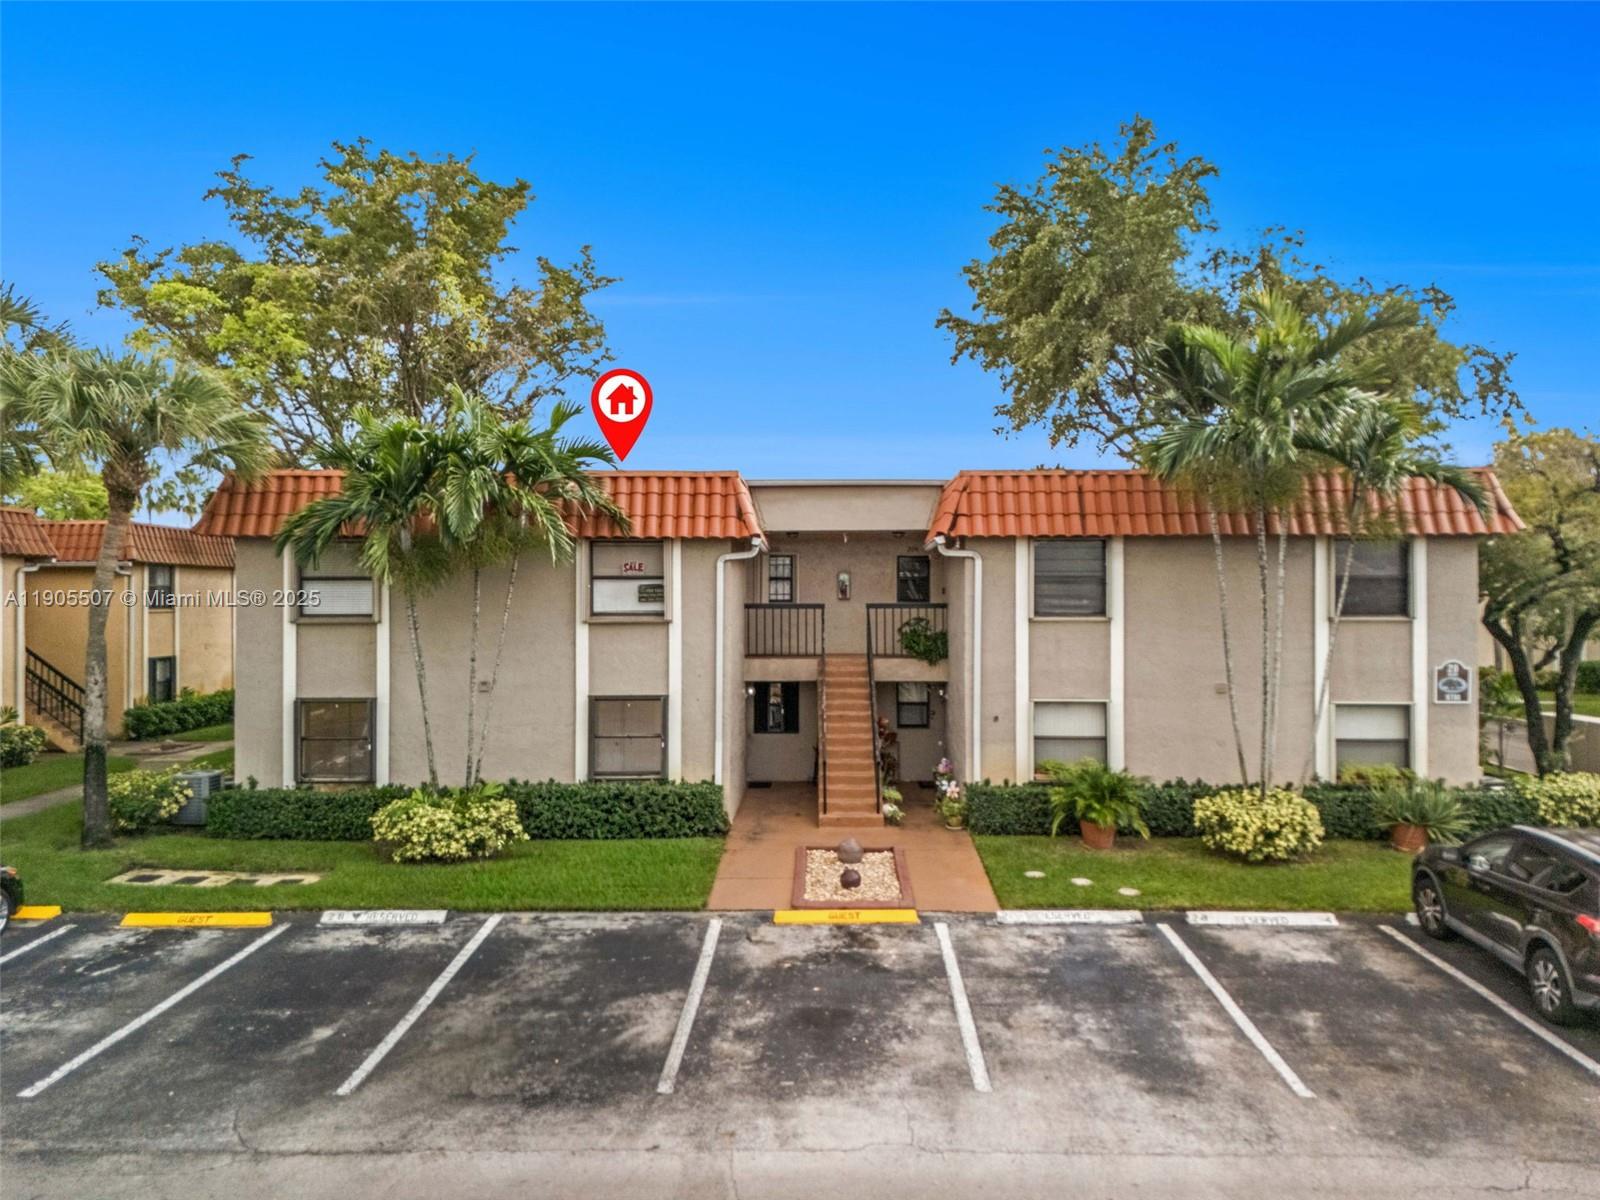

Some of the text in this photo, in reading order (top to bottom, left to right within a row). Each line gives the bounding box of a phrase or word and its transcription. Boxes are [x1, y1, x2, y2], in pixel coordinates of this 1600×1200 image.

[623, 562, 644, 573] SALE
[177, 915, 213, 924] GUEST
[828, 911, 861, 920] GUEST
